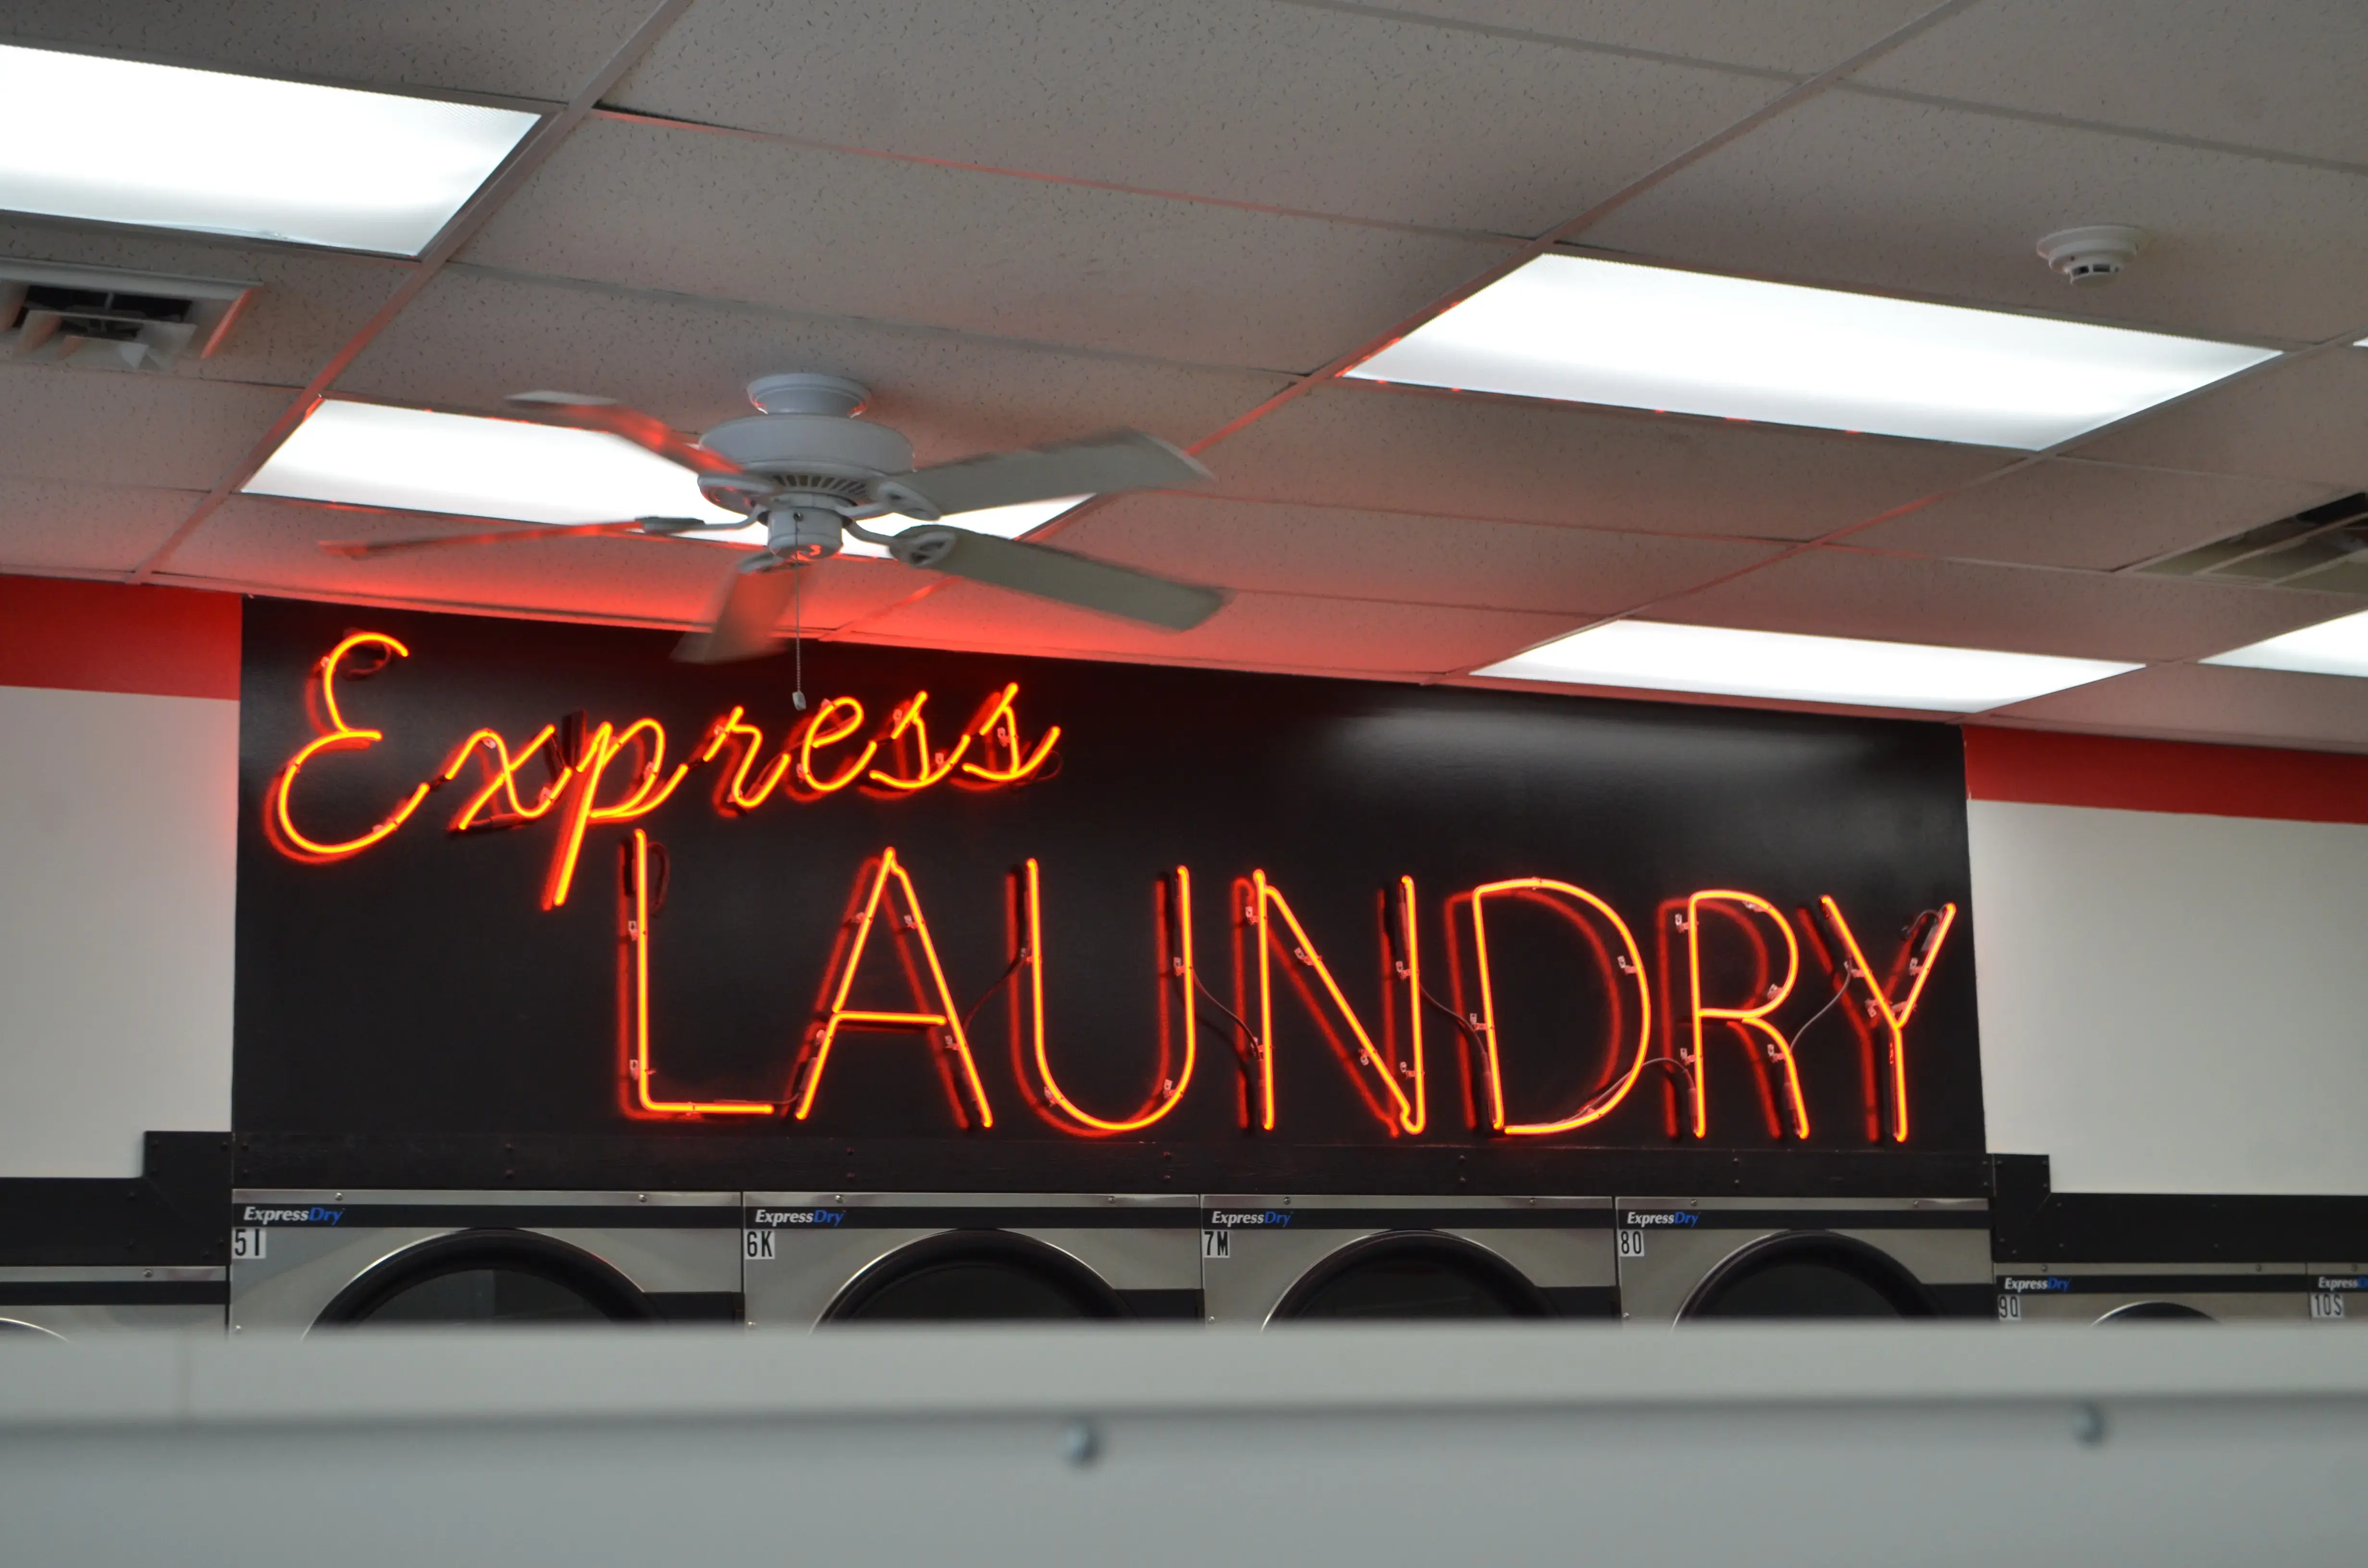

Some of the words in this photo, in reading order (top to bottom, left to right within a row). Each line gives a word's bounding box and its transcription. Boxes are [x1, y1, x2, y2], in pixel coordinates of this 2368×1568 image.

[270, 629, 1061, 909] Express
[620, 827, 1957, 1142] LAUNDRY
[244, 1206, 344, 1225] ExpressDry
[755, 1209, 844, 1227] ExpressDry
[1212, 1211, 1292, 1227] ExpressDry
[1627, 1211, 1699, 1228] ExpressDry
[747, 1231, 773, 1257] 6K
[1204, 1231, 1228, 1256] 7M
[2004, 1276, 2070, 1293] ExpressDry
[2315, 1293, 2342, 1316] 10S
